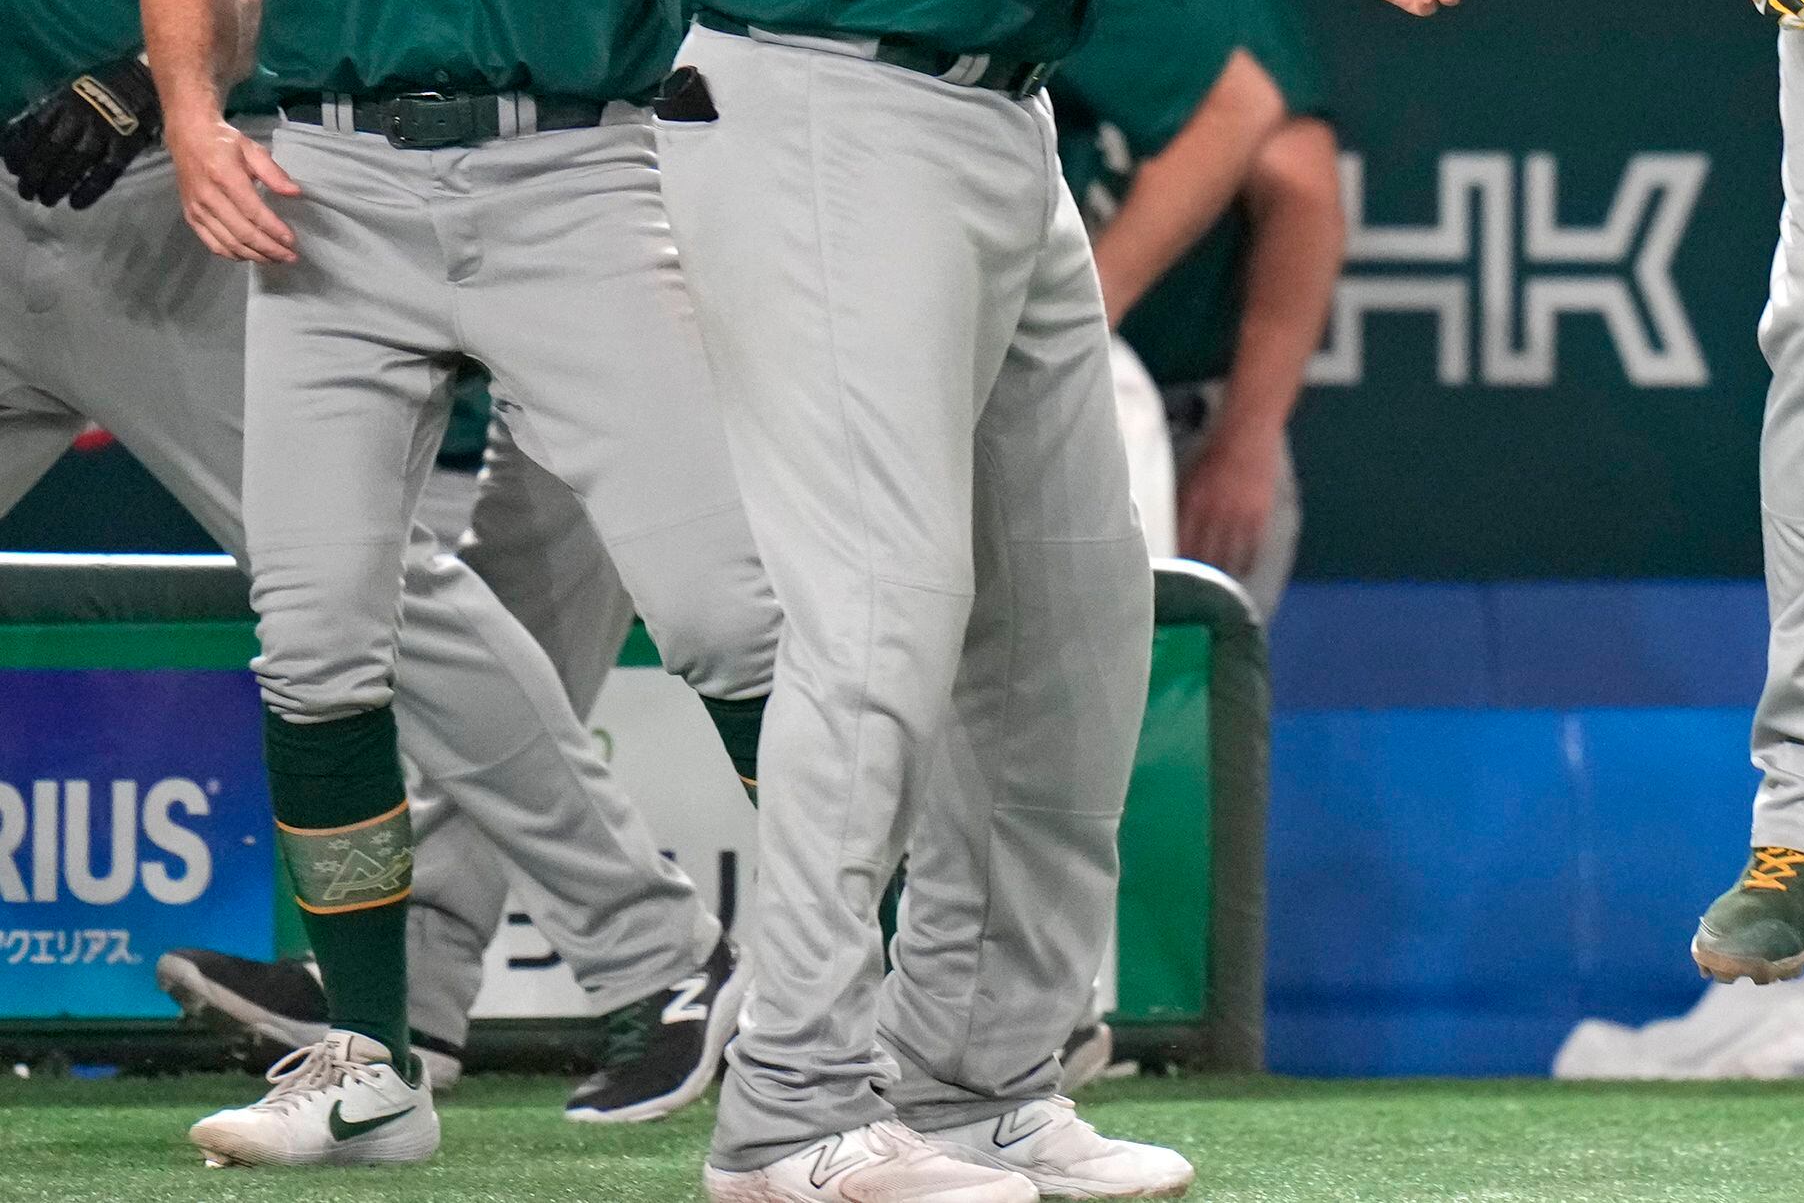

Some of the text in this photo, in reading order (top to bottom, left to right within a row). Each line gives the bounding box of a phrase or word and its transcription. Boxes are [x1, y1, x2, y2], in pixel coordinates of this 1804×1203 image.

[0, 928, 143, 965] クエリアス
